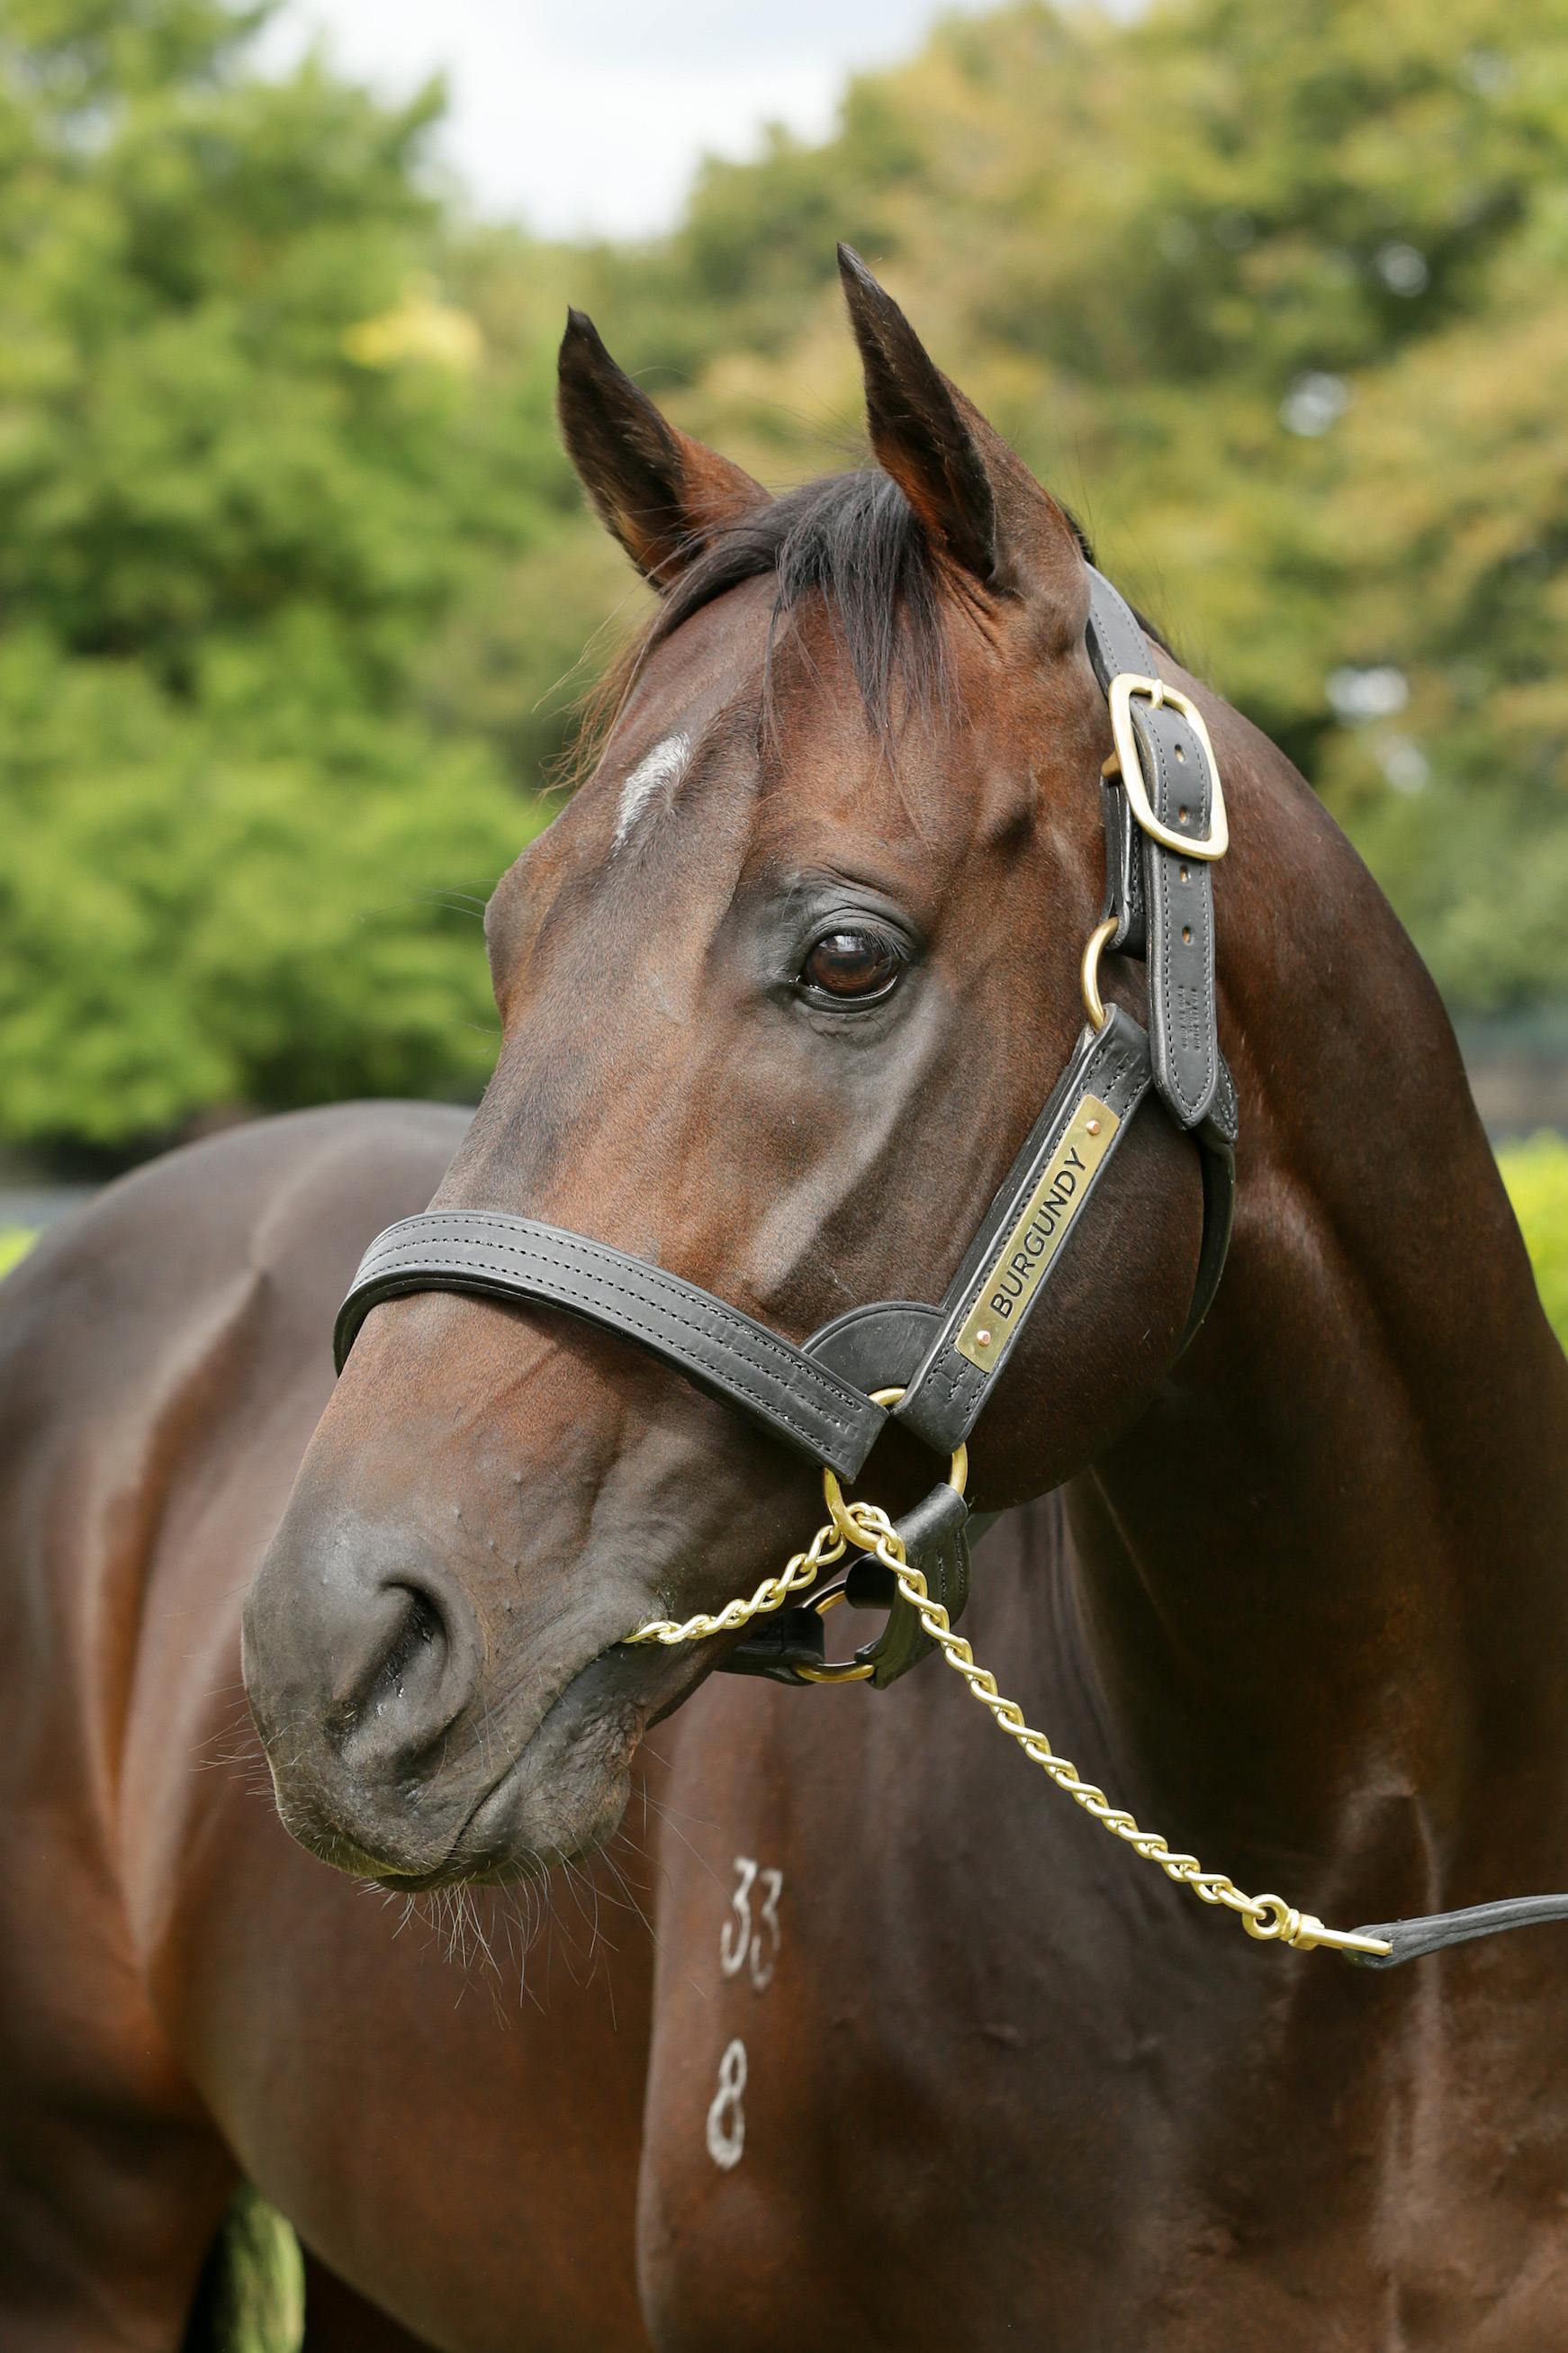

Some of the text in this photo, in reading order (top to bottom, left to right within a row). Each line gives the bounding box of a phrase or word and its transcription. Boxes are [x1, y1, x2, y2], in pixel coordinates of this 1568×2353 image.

[990, 1147, 1086, 1321] BURGUNDY
[721, 1855, 783, 1990] 33
[706, 2038, 747, 2171] 8
